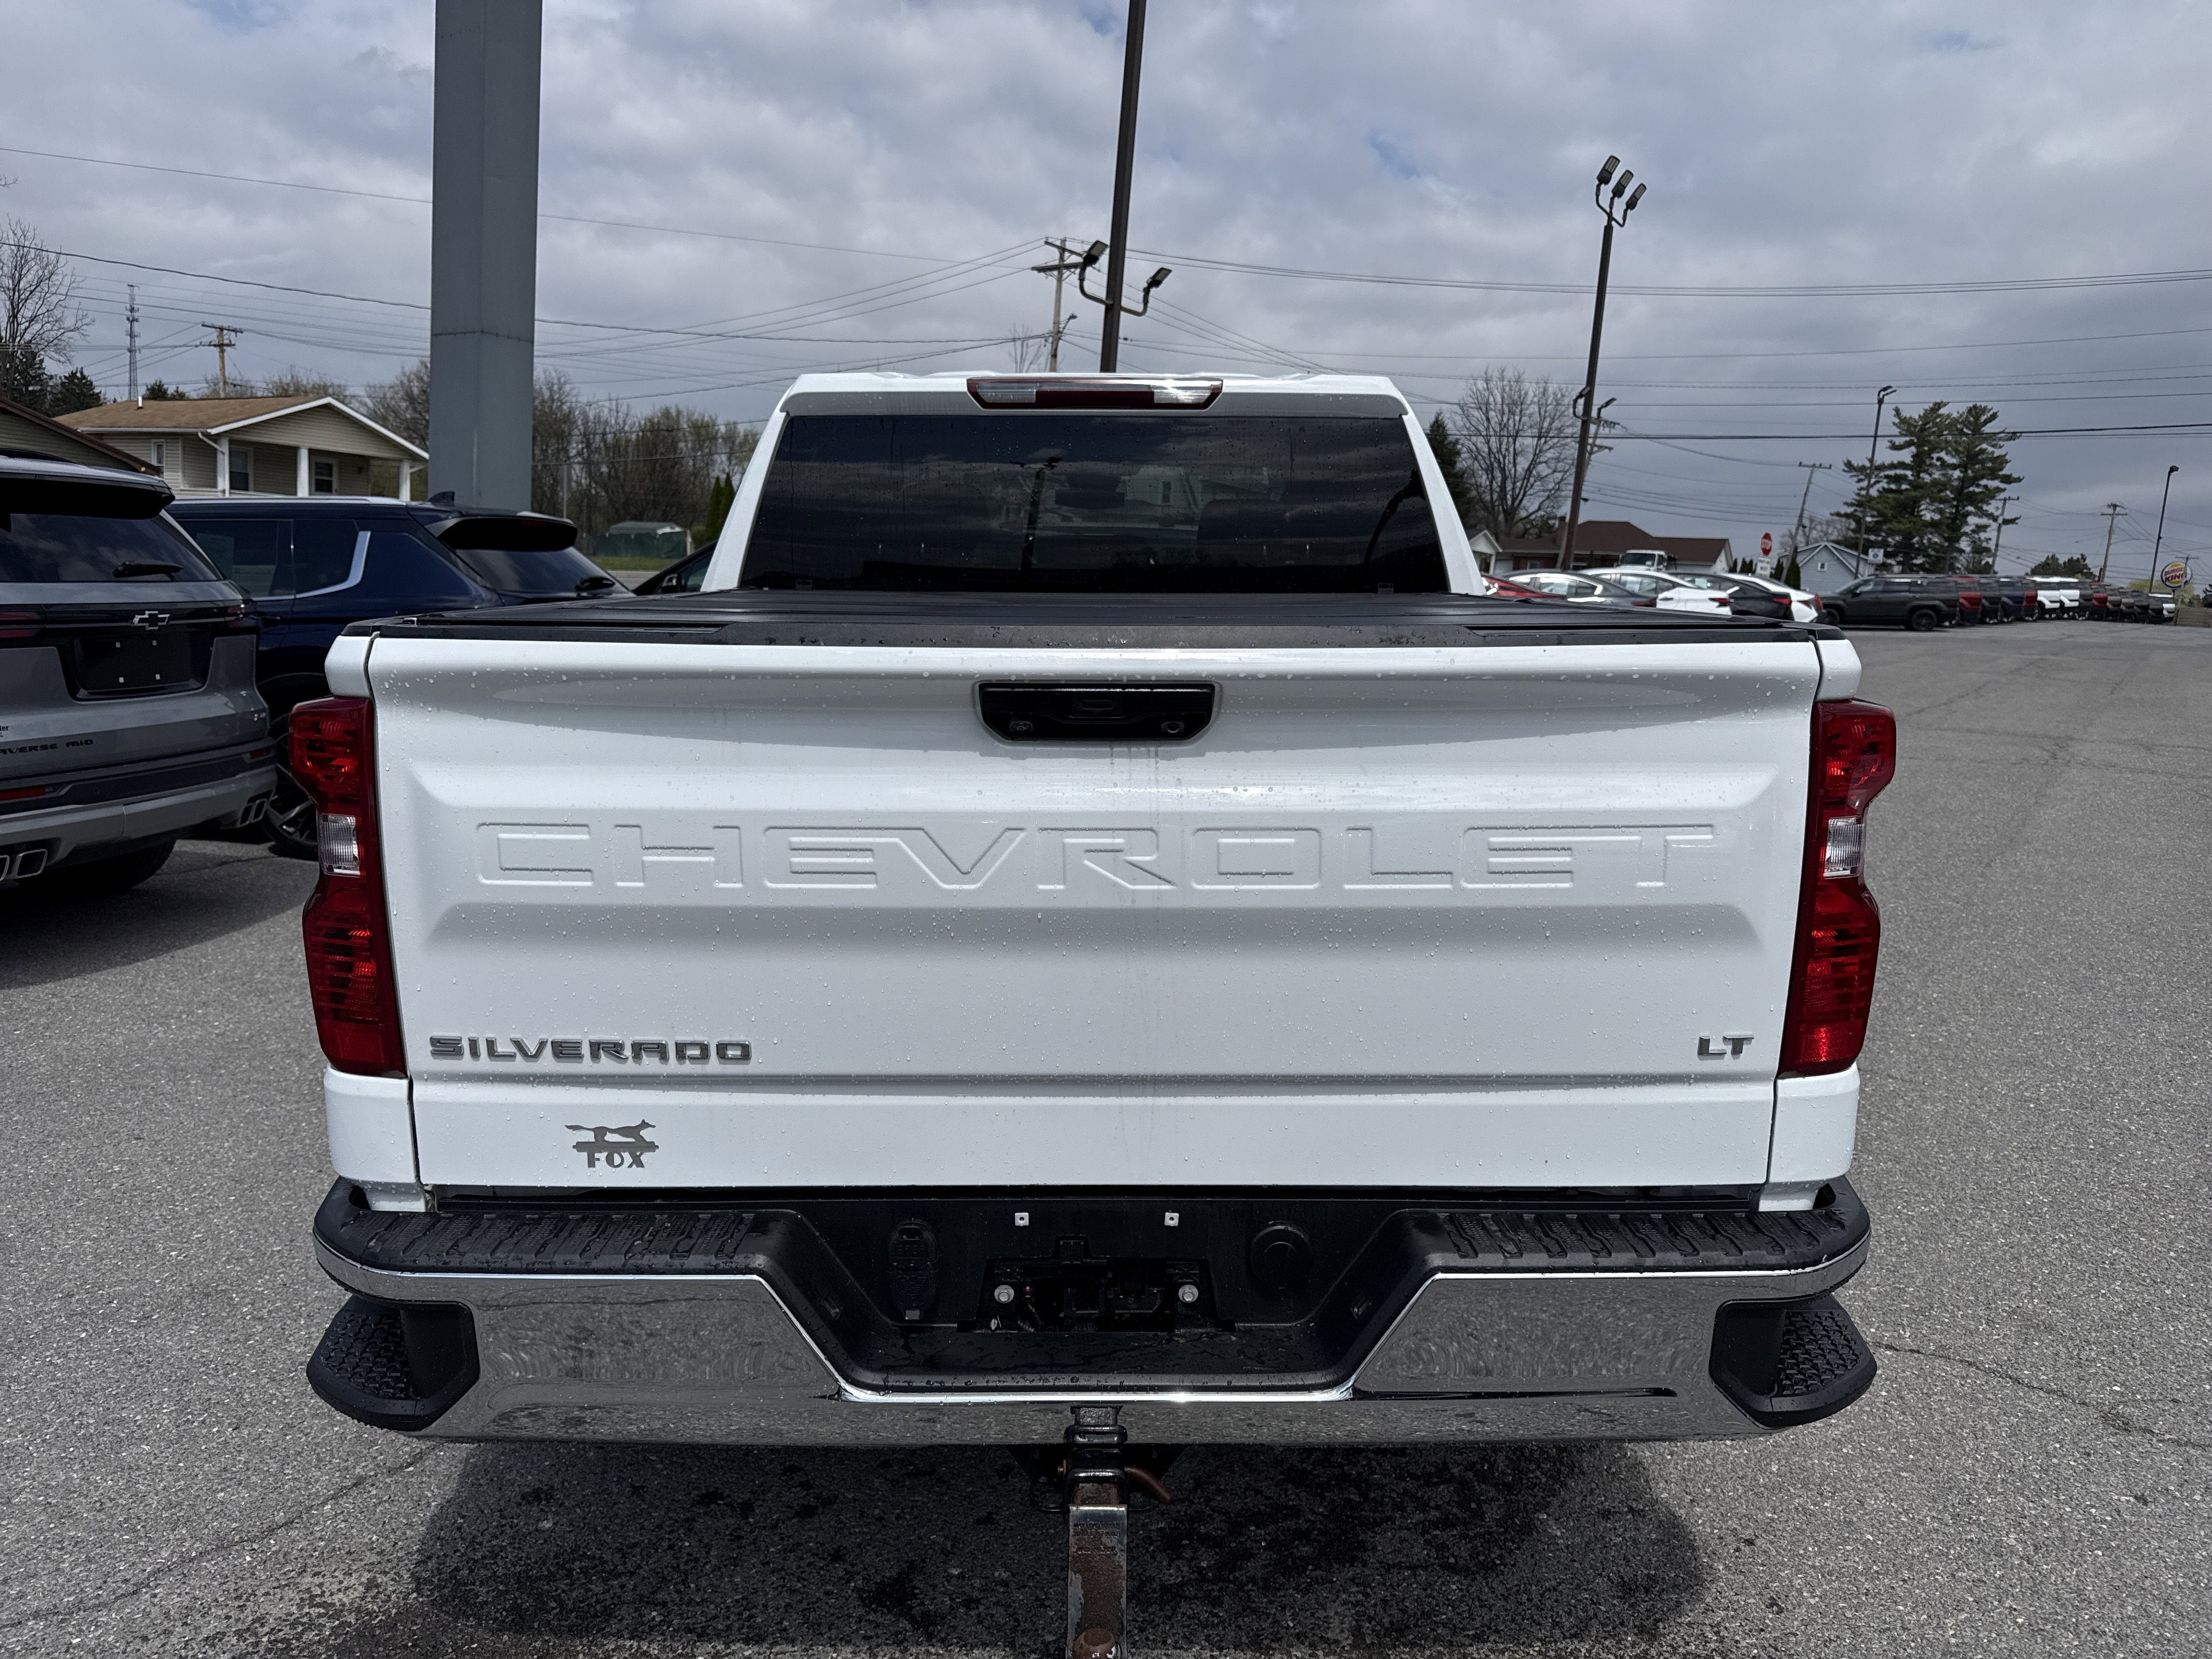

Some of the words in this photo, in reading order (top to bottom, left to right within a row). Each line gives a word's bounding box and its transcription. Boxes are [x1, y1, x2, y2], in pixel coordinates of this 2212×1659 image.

[476, 822, 1715, 890] CHEVROLET
[430, 1035, 752, 1060] SILVERADO
[1697, 1034, 1754, 1060] LT
[586, 1152, 646, 1169] FOX
